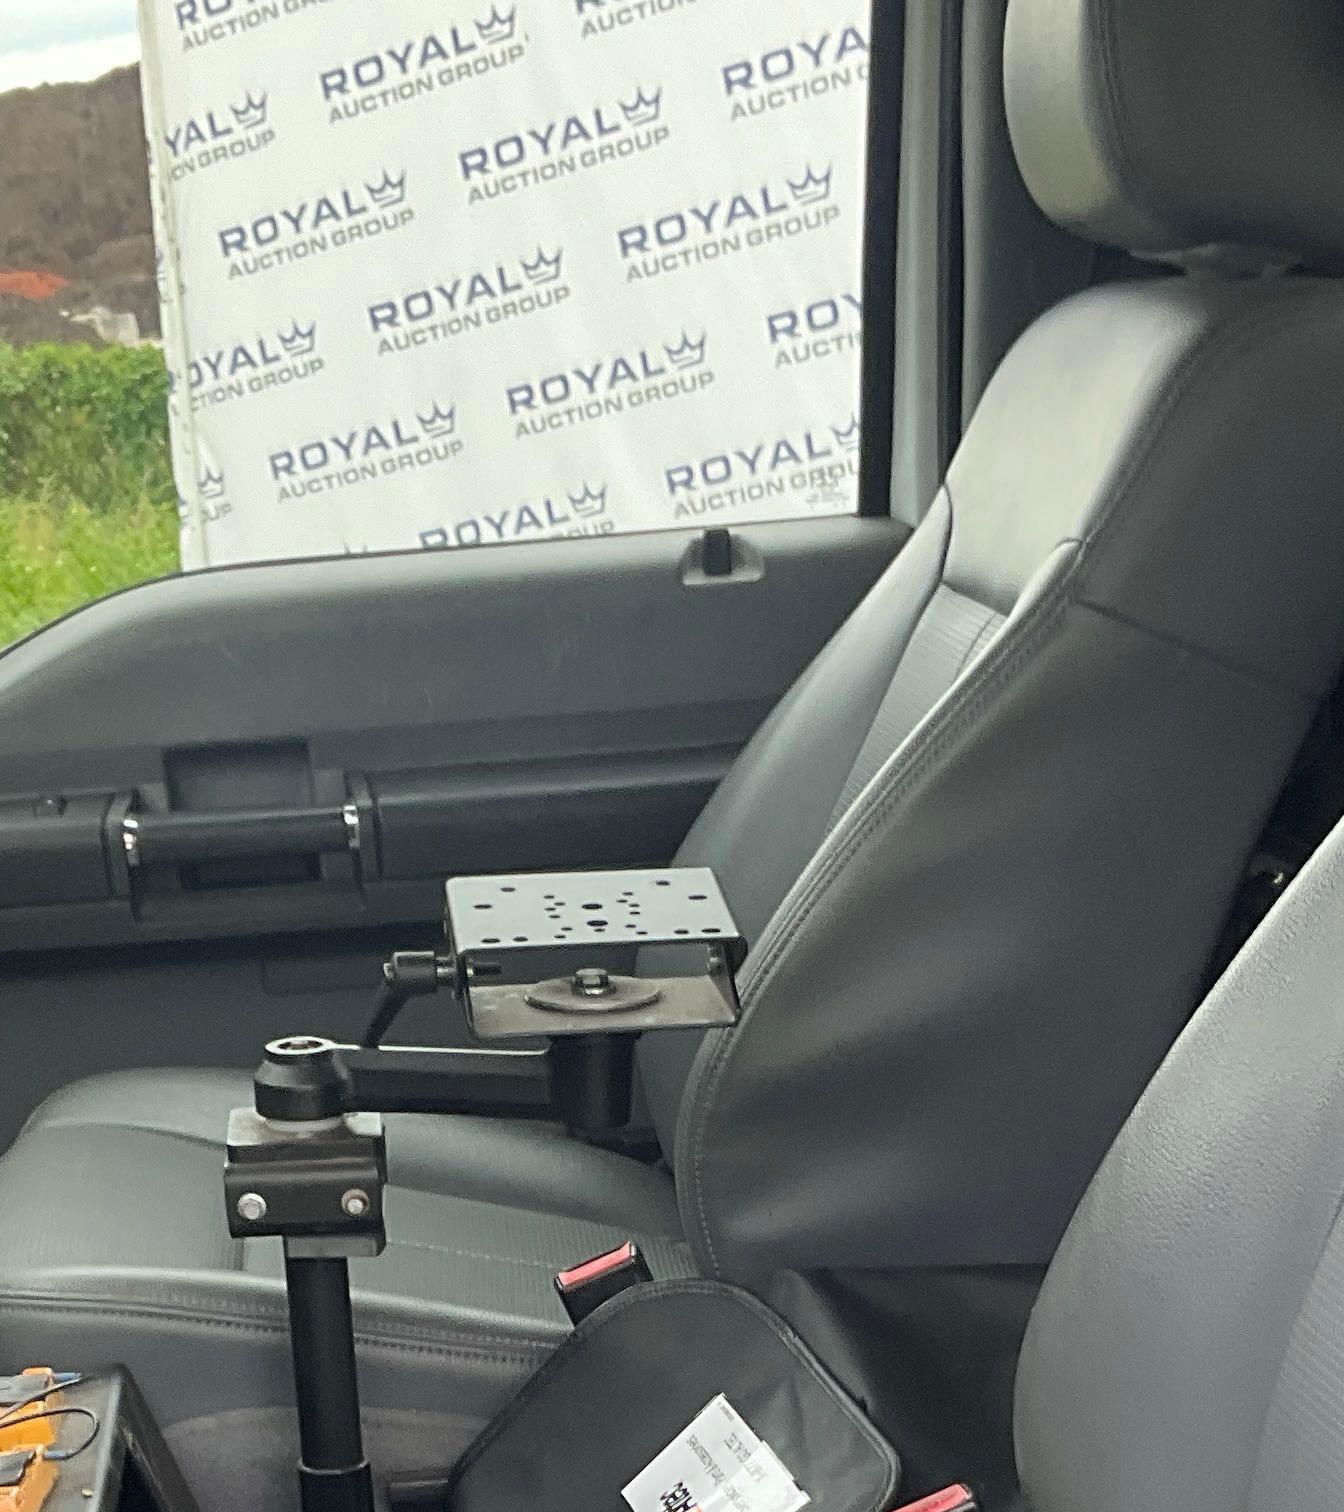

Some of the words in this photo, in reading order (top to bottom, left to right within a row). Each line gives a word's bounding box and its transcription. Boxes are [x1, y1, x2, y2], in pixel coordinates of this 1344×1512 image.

[181, 4, 280, 51] AUCTION
[721, 25, 868, 97] ROYA
[319, 25, 477, 101] ROYAL
[328, 74, 434, 125] AUCTION
[437, 44, 525, 88] GROUP
[729, 67, 852, 122] AUCTION
[164, 111, 233, 158] YAL
[197, 128, 276, 170] GROUP
[459, 107, 621, 181] ROYAL
[468, 156, 576, 206] AUCTION
[580, 126, 669, 169] GROUP
[218, 189, 367, 257] ROYAL
[228, 234, 328, 280] AUCTION
[332, 208, 415, 247] GROUP
[617, 184, 789, 258] ROYAL
[625, 232, 741, 283] AUCTION
[746, 203, 842, 249] GROUP
[368, 265, 522, 333] ROYAL
[377, 311, 482, 356] AUCTION
[485, 285, 571, 324] GROUP
[767, 293, 862, 344] ROY
[247, 357, 325, 394] GROUP
[507, 349, 666, 416] ROYAL
[514, 394, 623, 439] AUCTION
[627, 370, 715, 409] GROUP
[269, 419, 419, 481] ROYAL
[277, 462, 378, 503] AUCTION
[381, 438, 464, 478] GROUP
[665, 432, 833, 496] ROYAL
[419, 499, 570, 549] ROYAL
[673, 477, 784, 521] AUCTION
